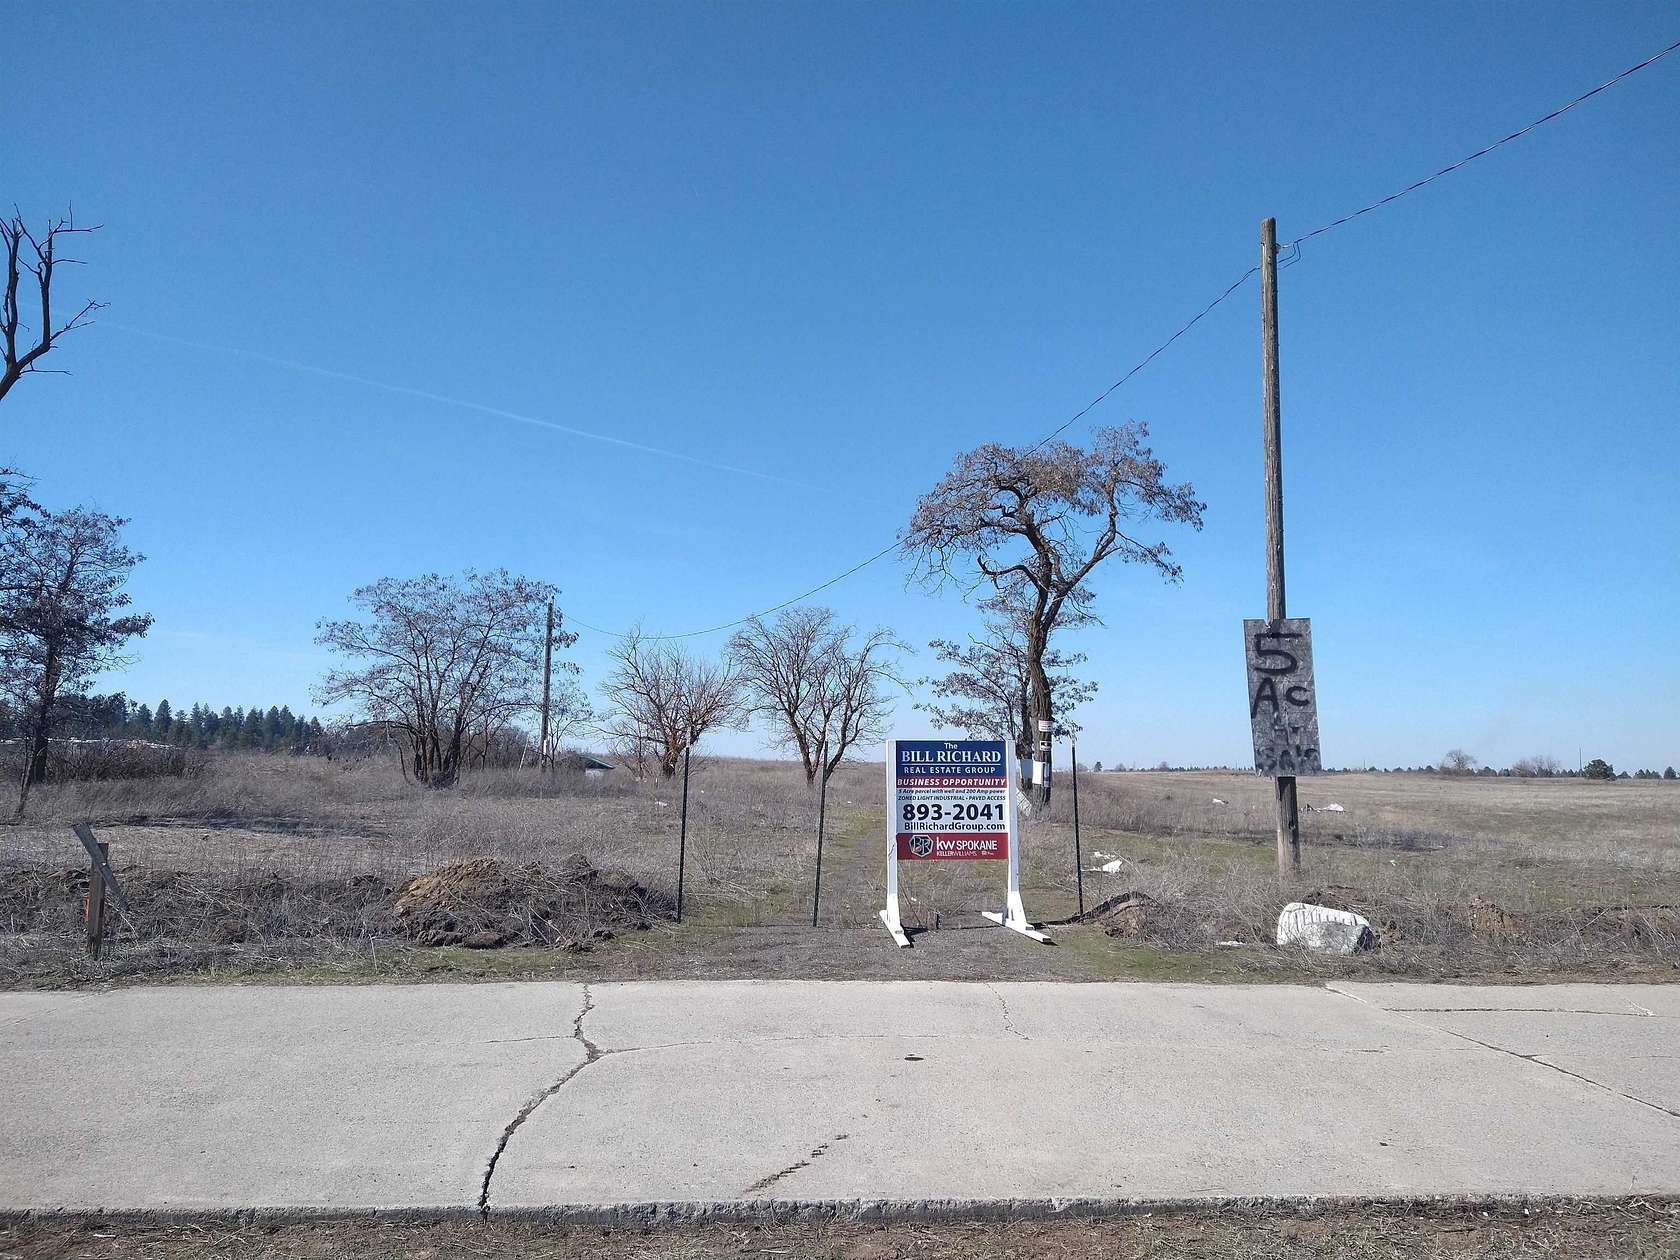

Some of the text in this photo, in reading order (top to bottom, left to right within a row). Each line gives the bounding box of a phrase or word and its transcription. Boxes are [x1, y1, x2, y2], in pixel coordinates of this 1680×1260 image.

[1253, 633, 1303, 675] 5
[944, 742, 958, 750] The
[901, 750, 1001, 762] BILL RICHARD
[904, 766, 996, 774] REAL ESTATE GROUP
[897, 778, 1006, 786] BUSINESS OPPORTUNITY
[902, 803, 1004, 821] 893-2041
[904, 822, 1006, 832] BillRichardGroup.com
[956, 840, 997, 850] SPOKANE
